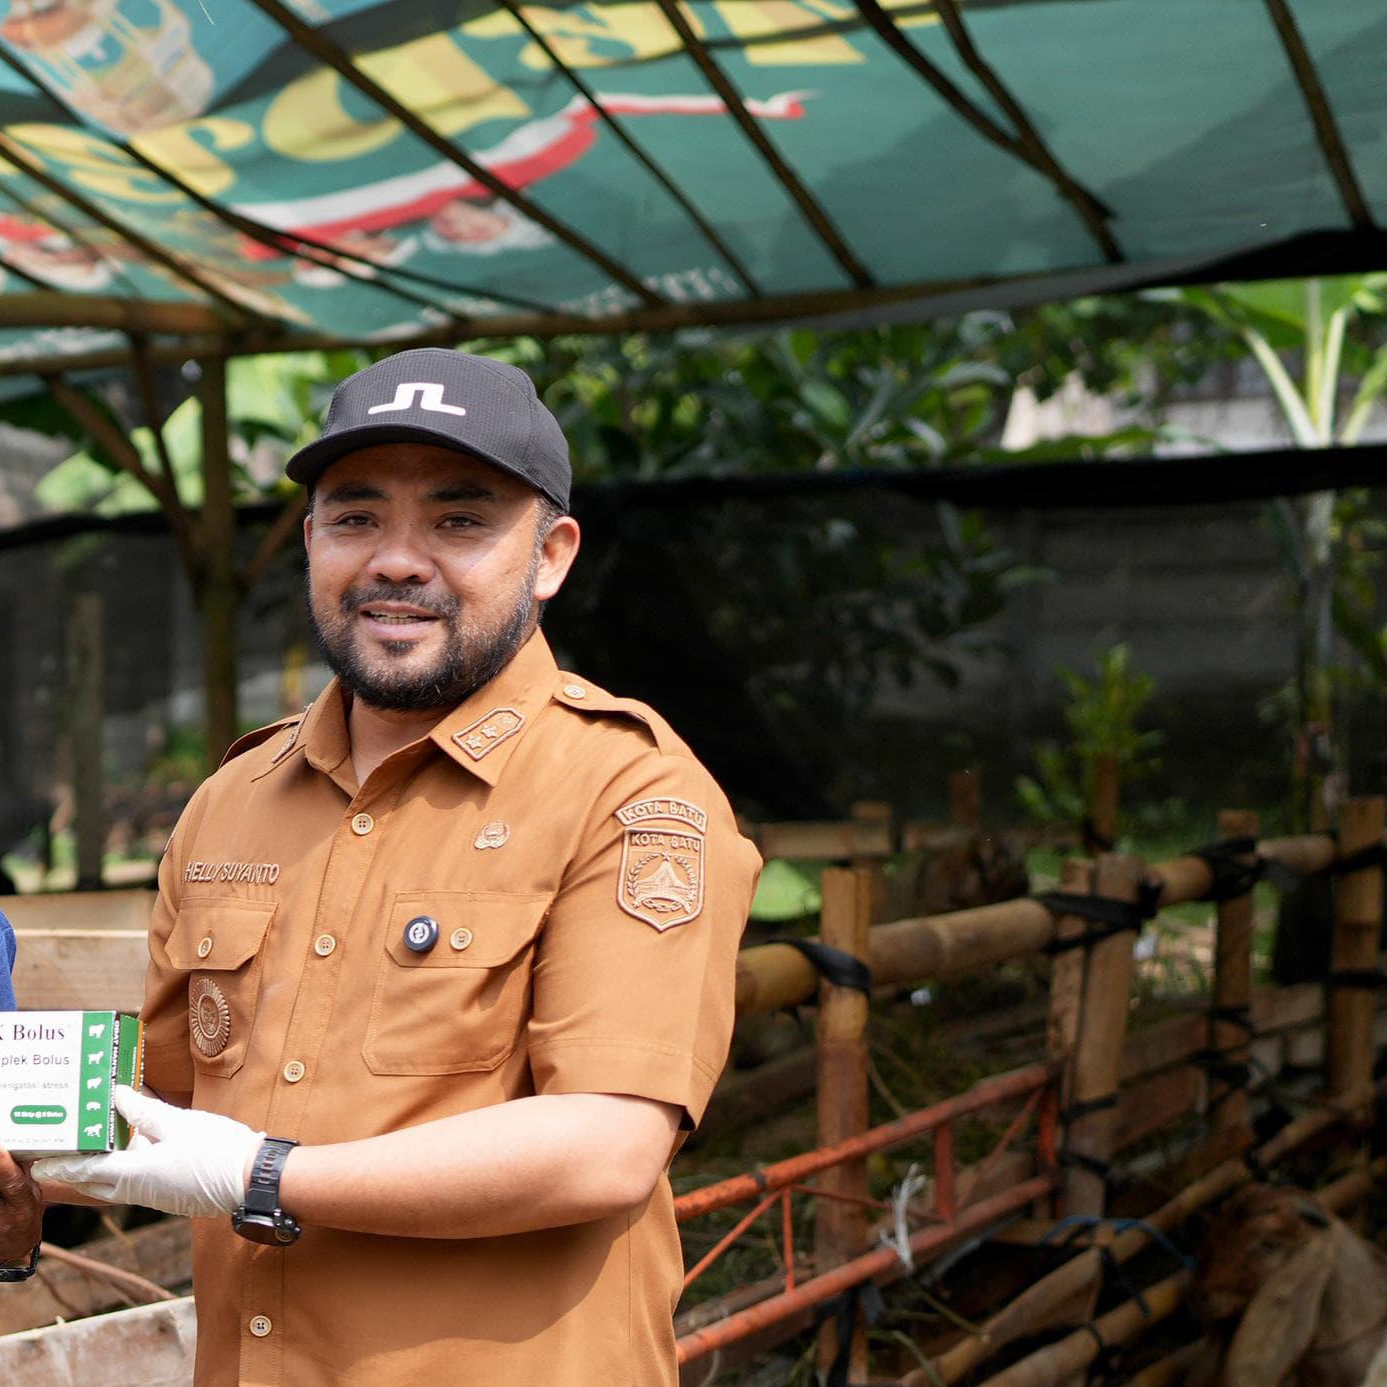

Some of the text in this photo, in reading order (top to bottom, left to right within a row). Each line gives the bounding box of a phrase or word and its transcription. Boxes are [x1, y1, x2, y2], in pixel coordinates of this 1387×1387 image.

[623, 801, 703, 825] KOTA BATU
[630, 833, 700, 852] KOTA BATU
[185, 861, 280, 885] HELLY SUYANTO
[13, 1023, 65, 1041] Bolus
[33, 1054, 70, 1066] Bolus
